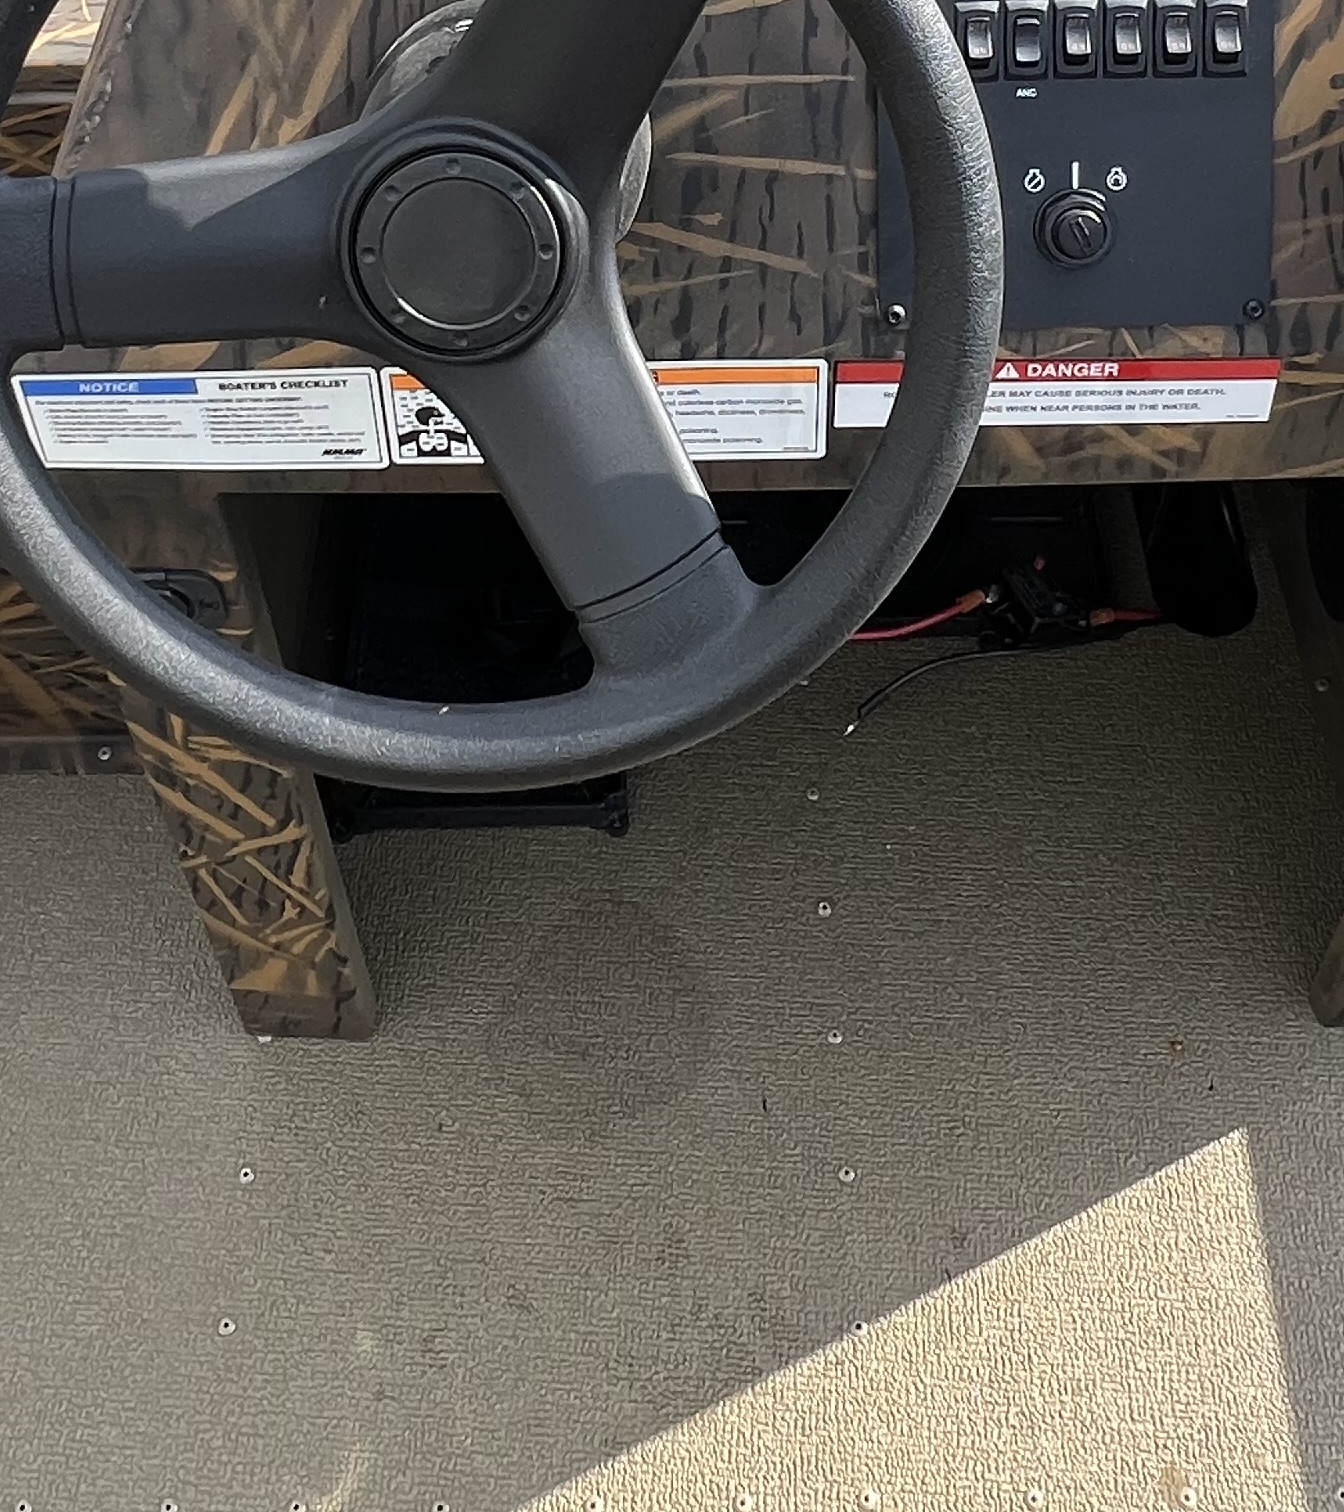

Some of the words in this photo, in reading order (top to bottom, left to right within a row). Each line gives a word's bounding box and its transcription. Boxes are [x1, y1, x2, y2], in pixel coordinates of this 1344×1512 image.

[1026, 362, 1119, 378] DANGER
[78, 382, 139, 393] NOTICE
[218, 382, 277, 390] BOATER'S
[280, 379, 348, 389] CHECKLIST
